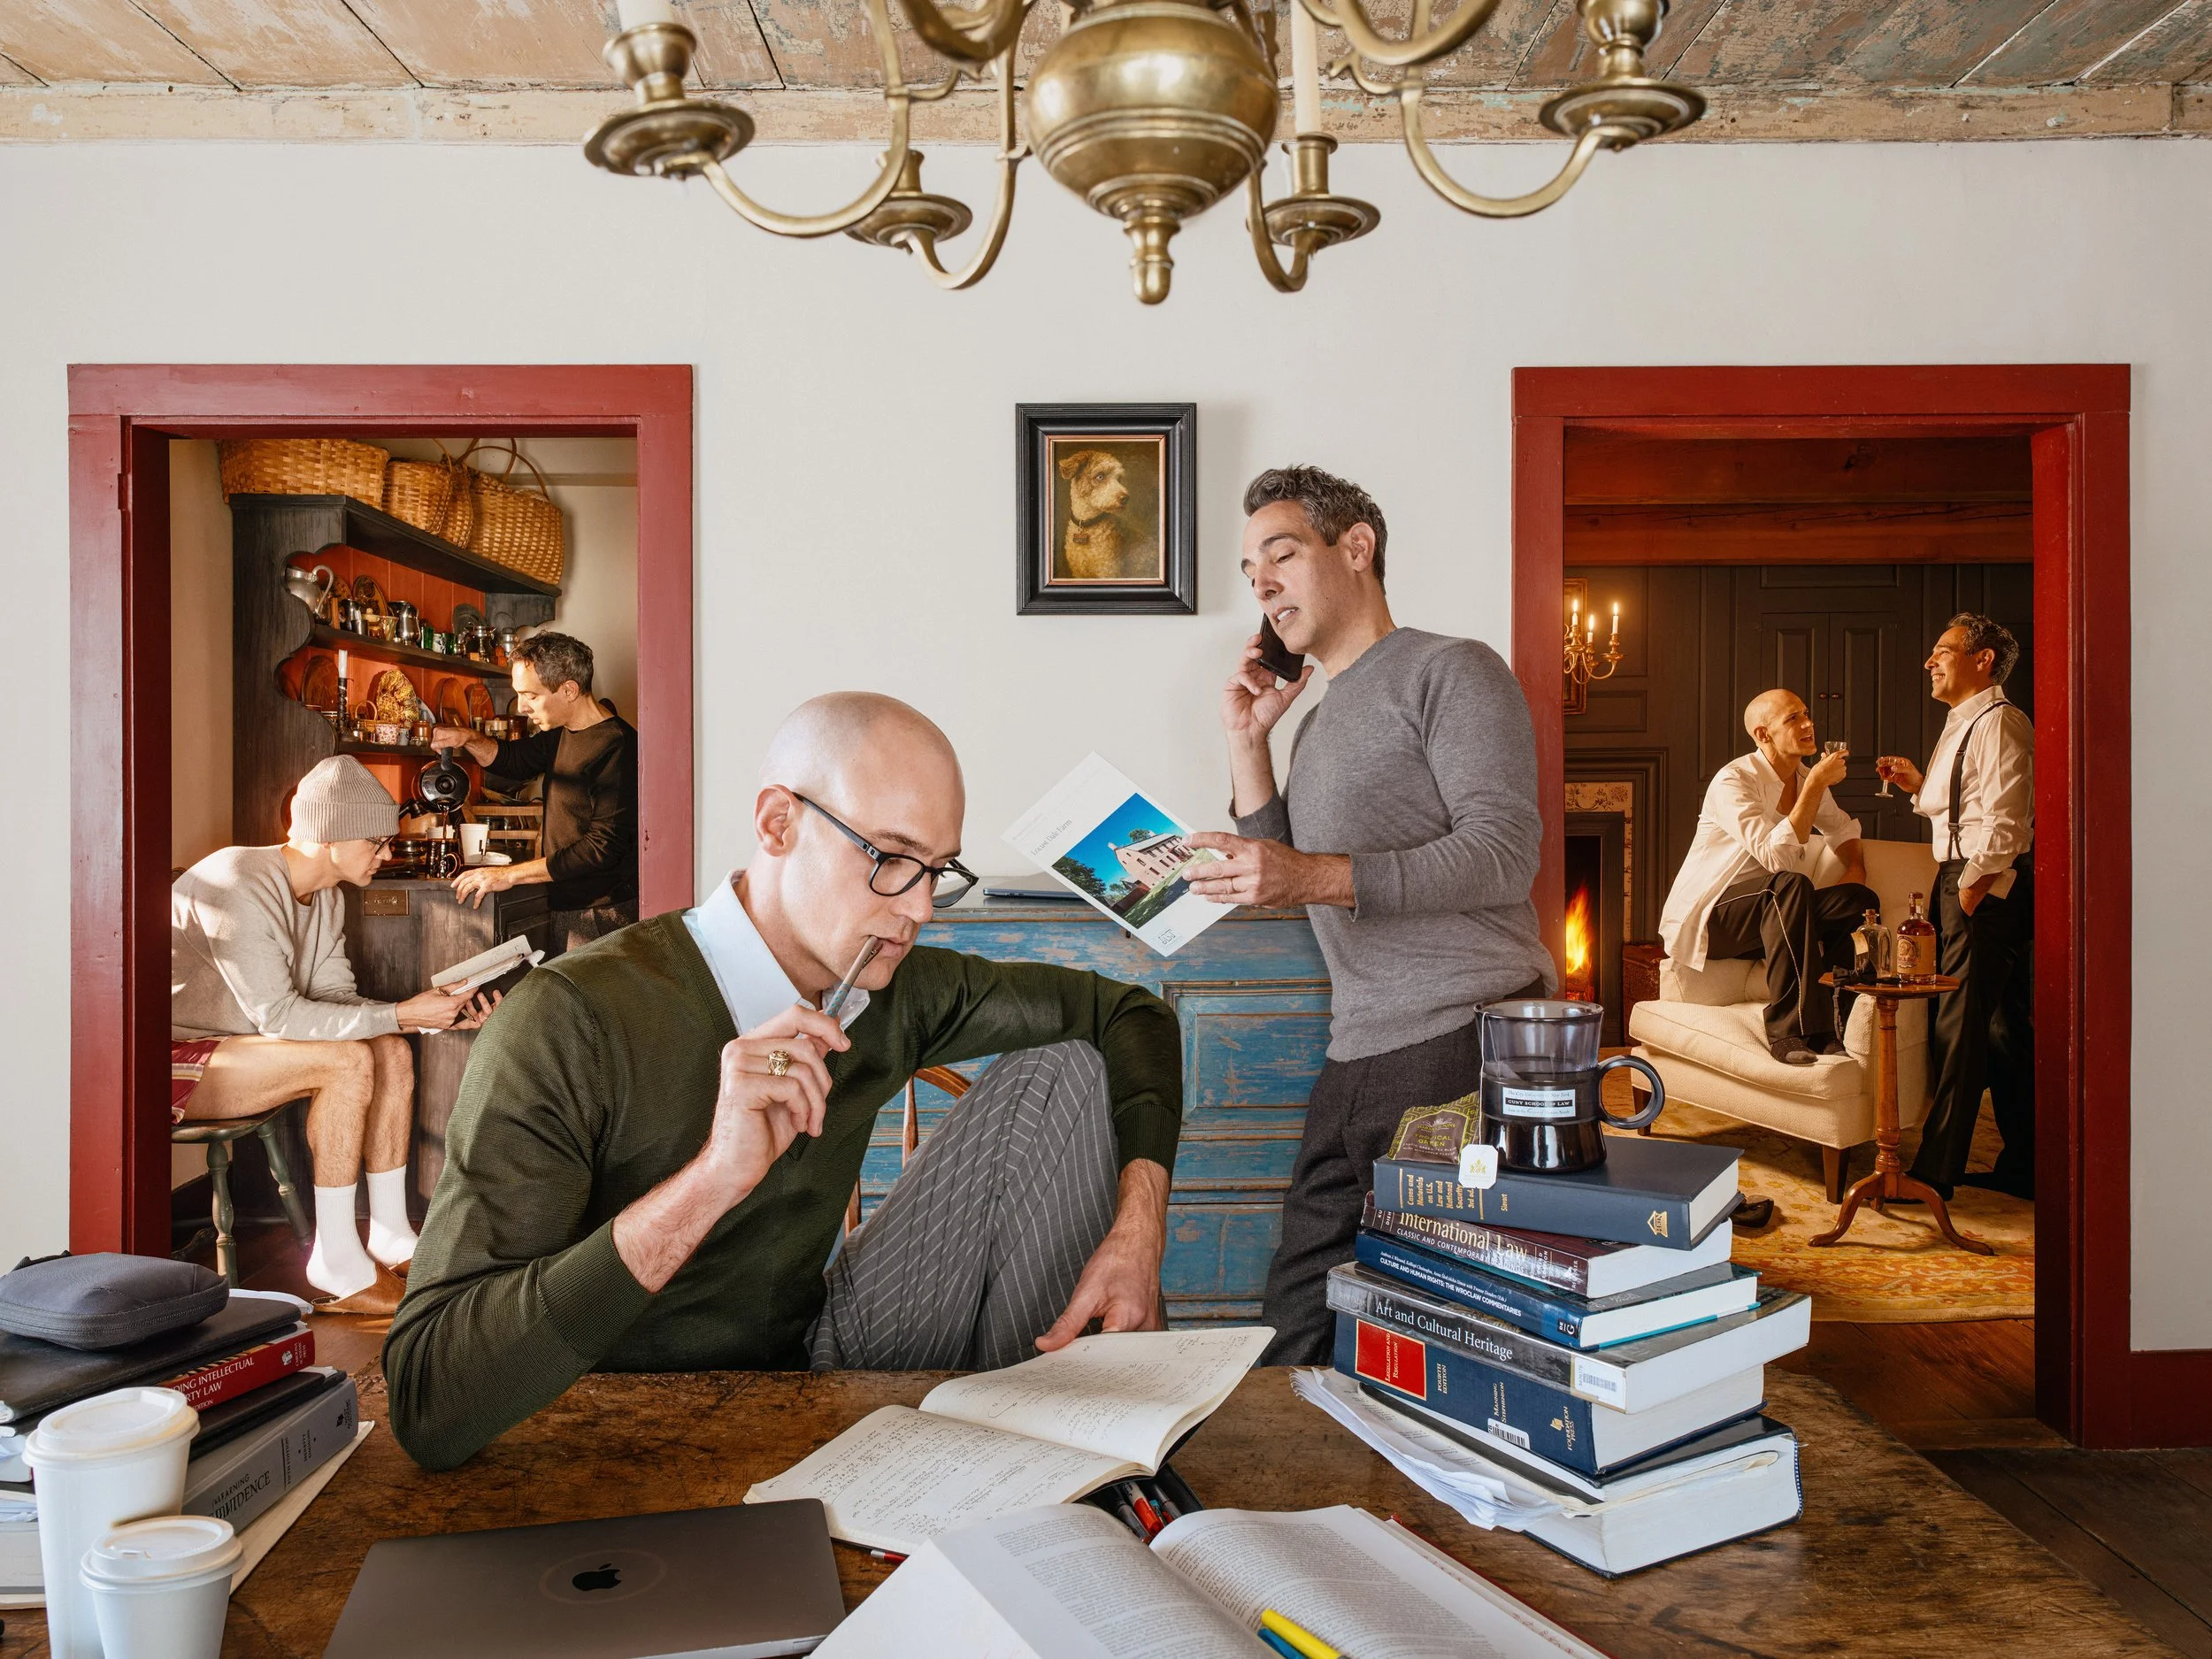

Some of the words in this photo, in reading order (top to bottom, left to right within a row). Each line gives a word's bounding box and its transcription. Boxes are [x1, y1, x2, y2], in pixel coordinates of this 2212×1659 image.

[1396, 1228, 1420, 1240] CLASSIC
[1421, 1236, 1435, 1245] AND
[1399, 1212, 1490, 1251] International
[1495, 1235, 1528, 1259] Law
[1379, 1256, 1400, 1271] CULTURE
[1399, 1264, 1410, 1274] AND
[1409, 1268, 1427, 1281] HUMAN
[1426, 1275, 1445, 1288] RIGHTS:
[1445, 1282, 1455, 1292] THE
[1455, 1286, 1482, 1302] WROCLAW
[1481, 1296, 1522, 1317] COMMENTARIES
[1375, 1301, 1393, 1318] Art
[1394, 1310, 1415, 1325] and
[1417, 1315, 1462, 1342] Cultural
[1463, 1331, 1513, 1362] Heritage
[198, 1356, 256, 1386] INTELLECTUAL
[204, 1380, 222, 1396] LAW
[194, 1399, 213, 1410] DITION
[1563, 1406, 1572, 1451] FOUNDATION
